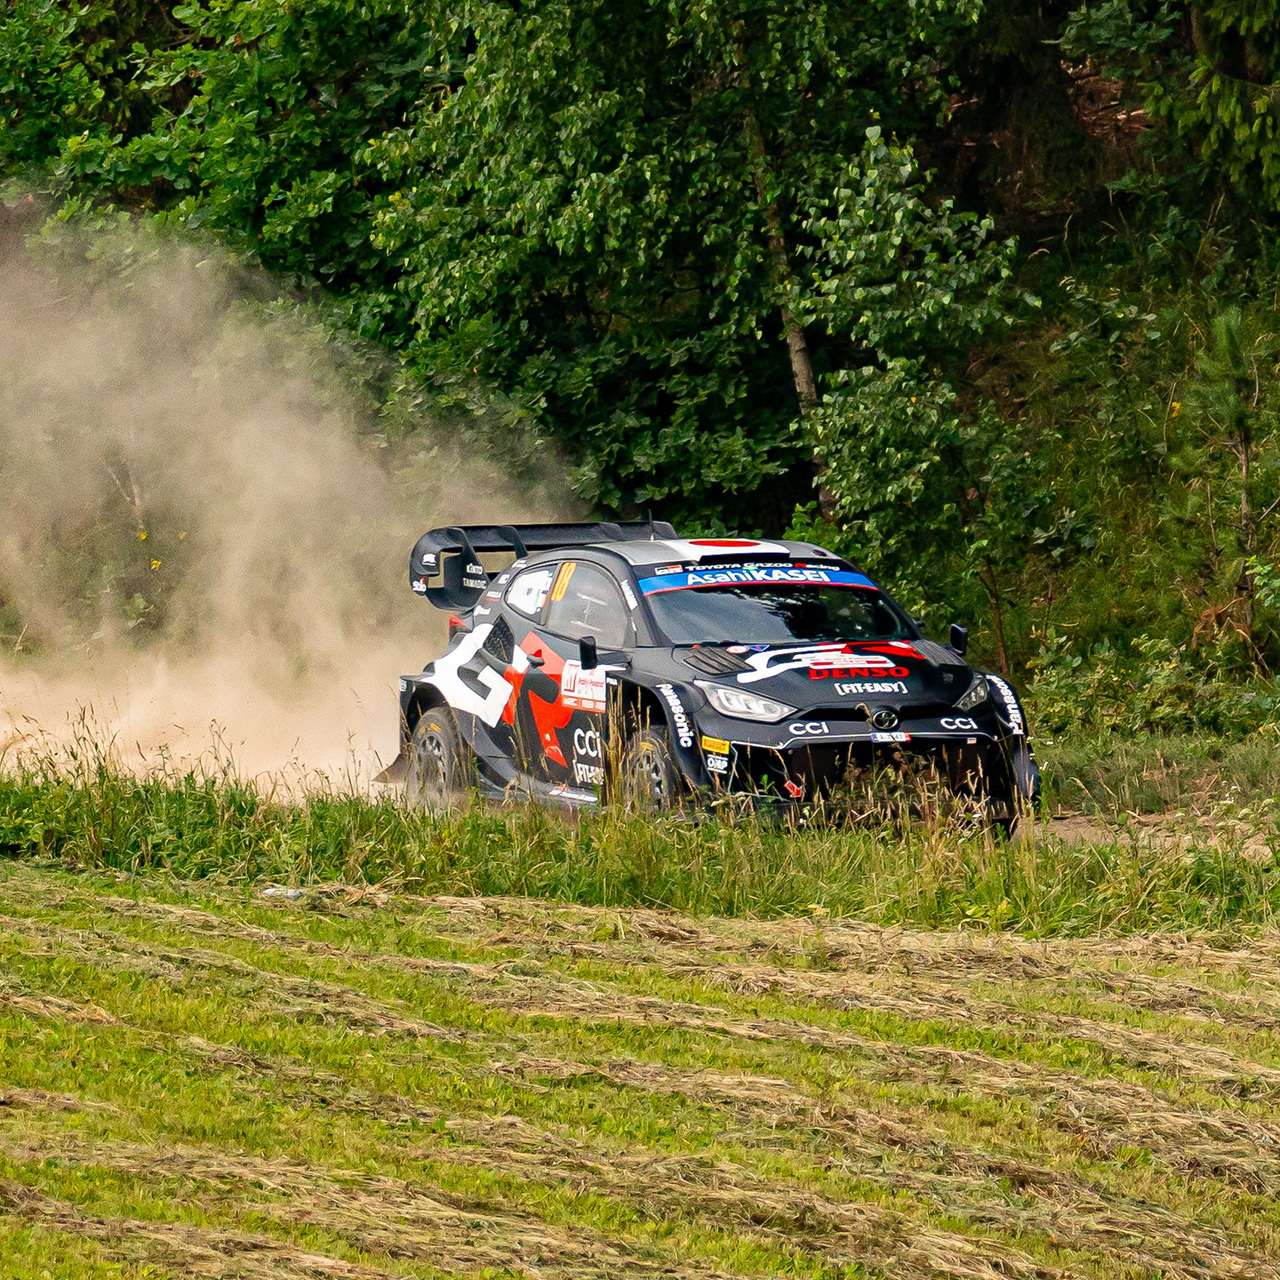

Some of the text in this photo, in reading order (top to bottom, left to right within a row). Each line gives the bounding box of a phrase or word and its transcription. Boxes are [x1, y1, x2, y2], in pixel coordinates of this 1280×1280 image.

[685, 563, 741, 571] TOYOTA
[743, 562, 793, 570] GAZOO
[808, 666, 910, 680] DENSO
[655, 683, 694, 748] Panasonic
